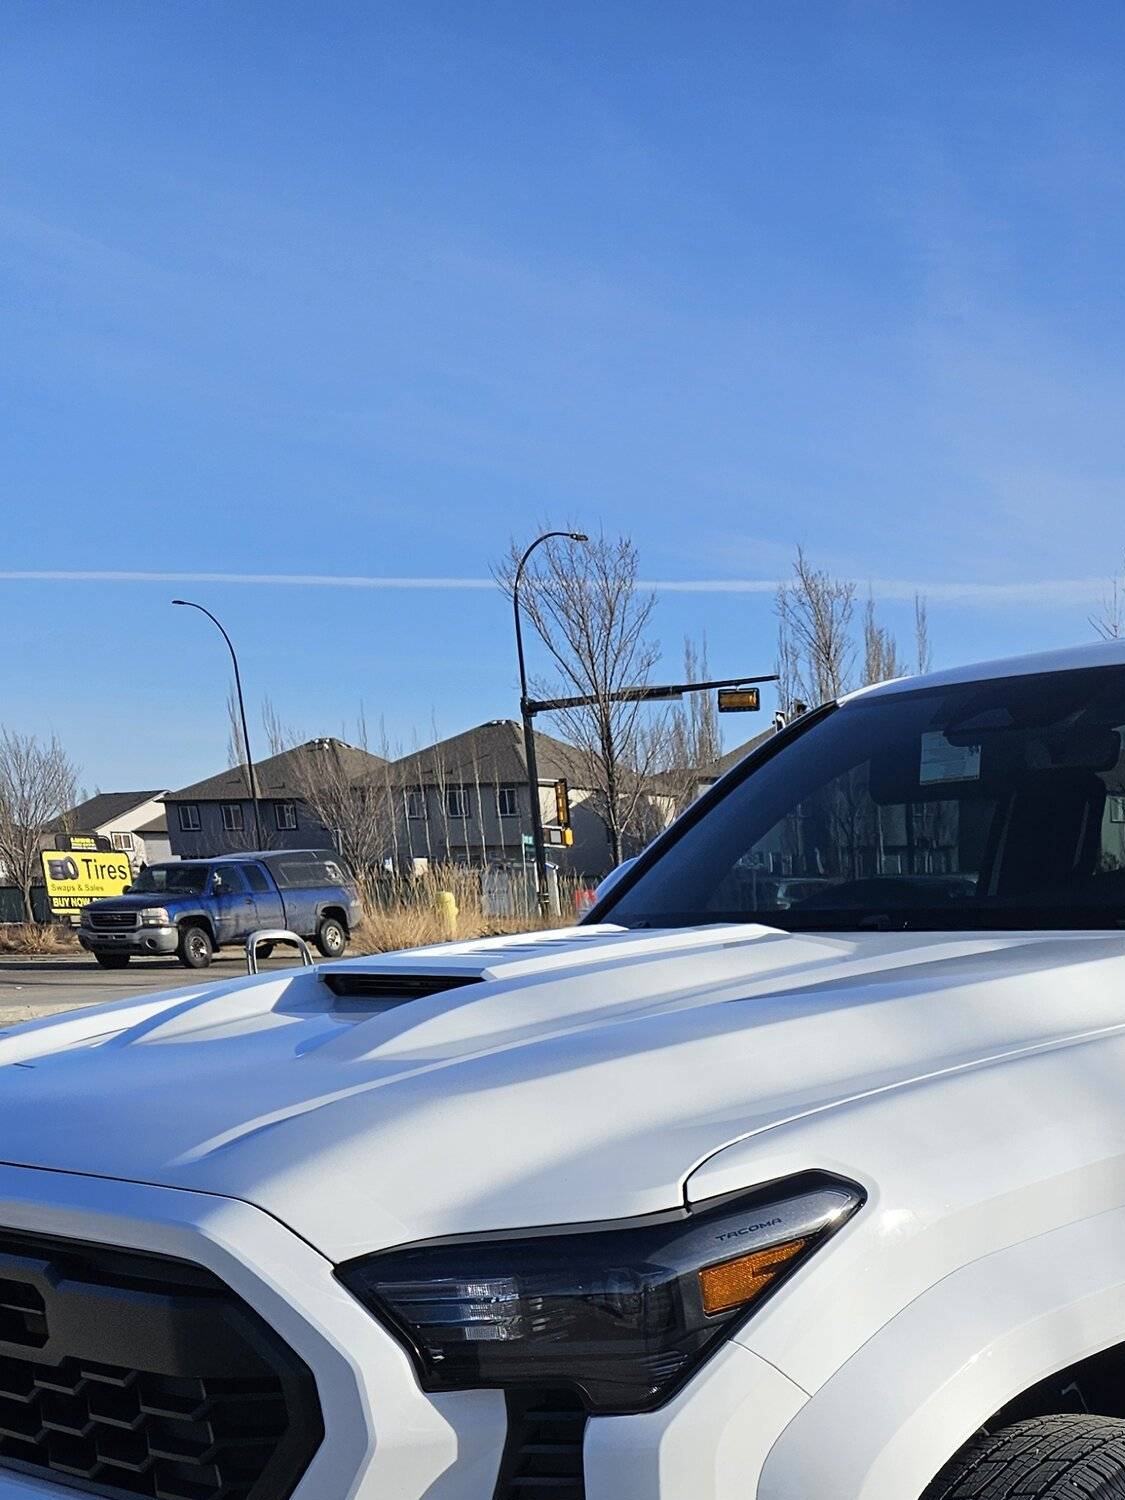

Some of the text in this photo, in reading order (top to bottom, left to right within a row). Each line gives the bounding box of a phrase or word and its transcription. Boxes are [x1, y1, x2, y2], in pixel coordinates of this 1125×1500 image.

[81, 858, 127, 880] Tires
[51, 883, 75, 892] Swaps
[52, 897, 69, 907] BUY
[715, 1218, 783, 1241] TACOMA
